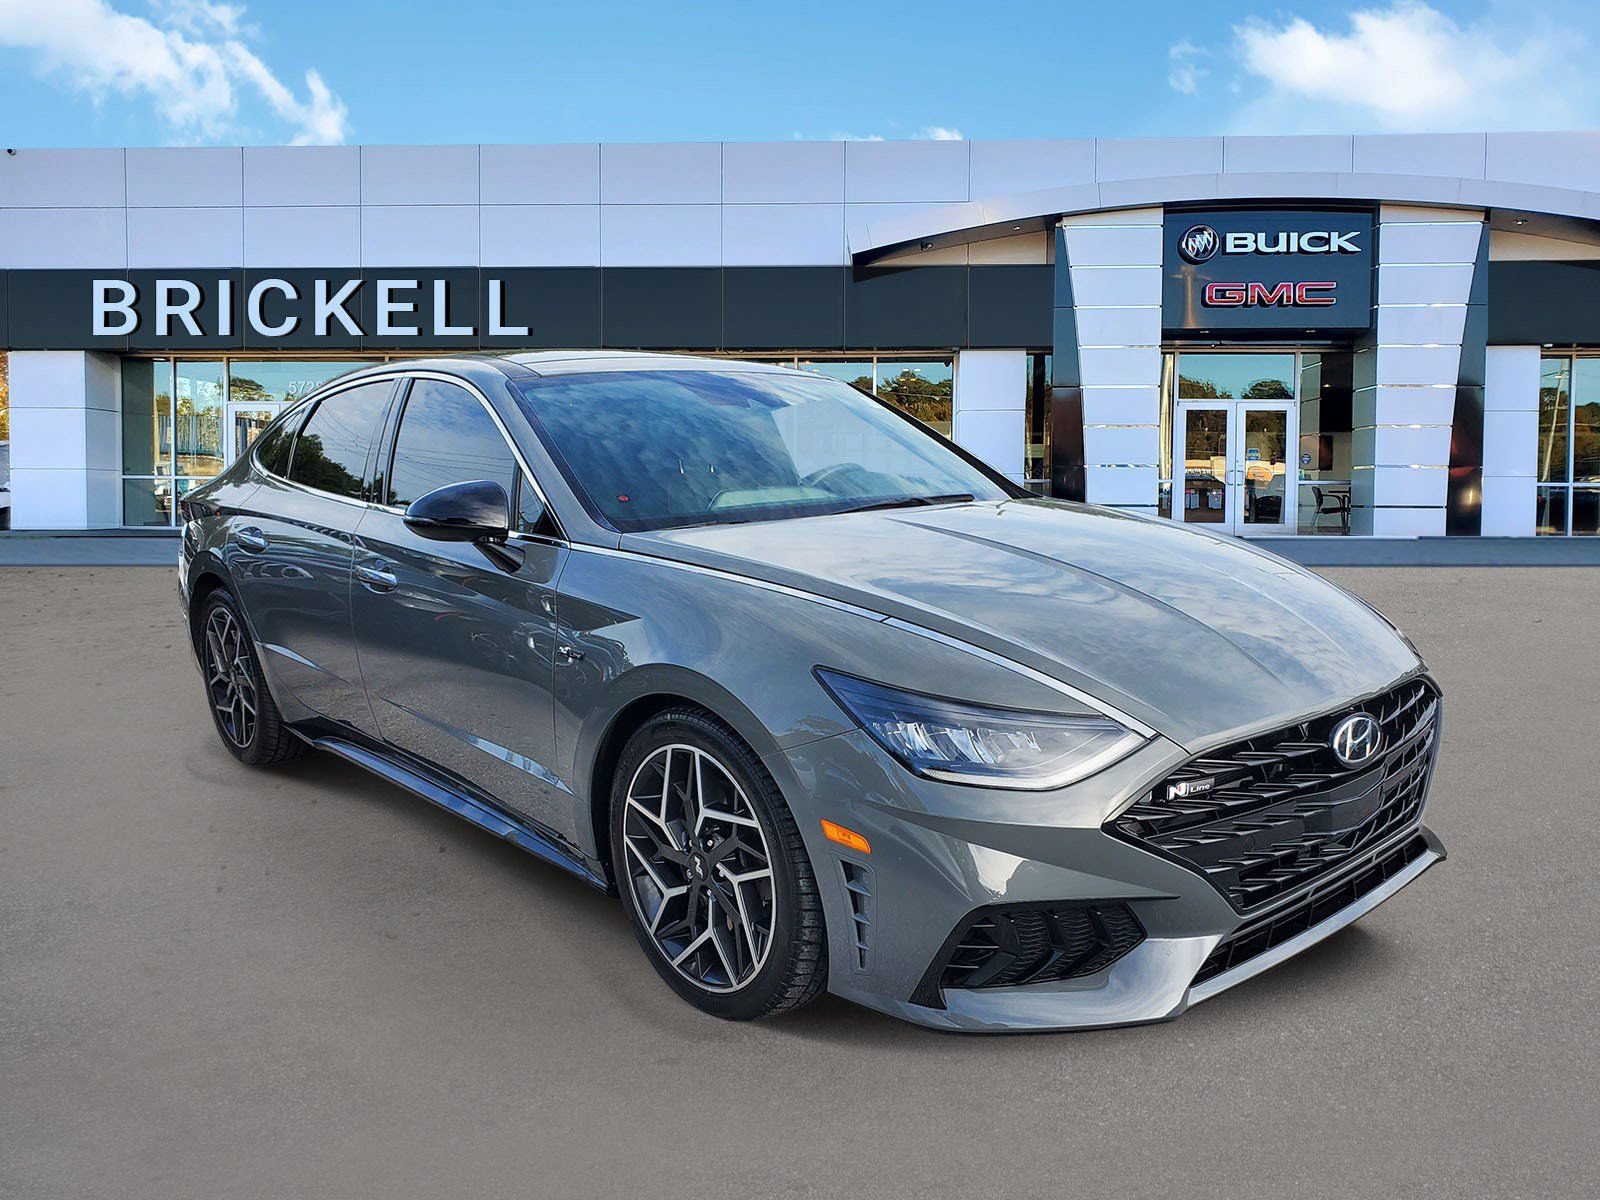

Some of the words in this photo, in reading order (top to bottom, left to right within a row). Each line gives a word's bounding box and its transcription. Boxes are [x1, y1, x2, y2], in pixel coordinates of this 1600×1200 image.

[1225, 231, 1362, 253] BUICK
[1205, 282, 1337, 305] GMC
[92, 278, 531, 337] BRICKELL
[1190, 784, 1211, 792] Line
